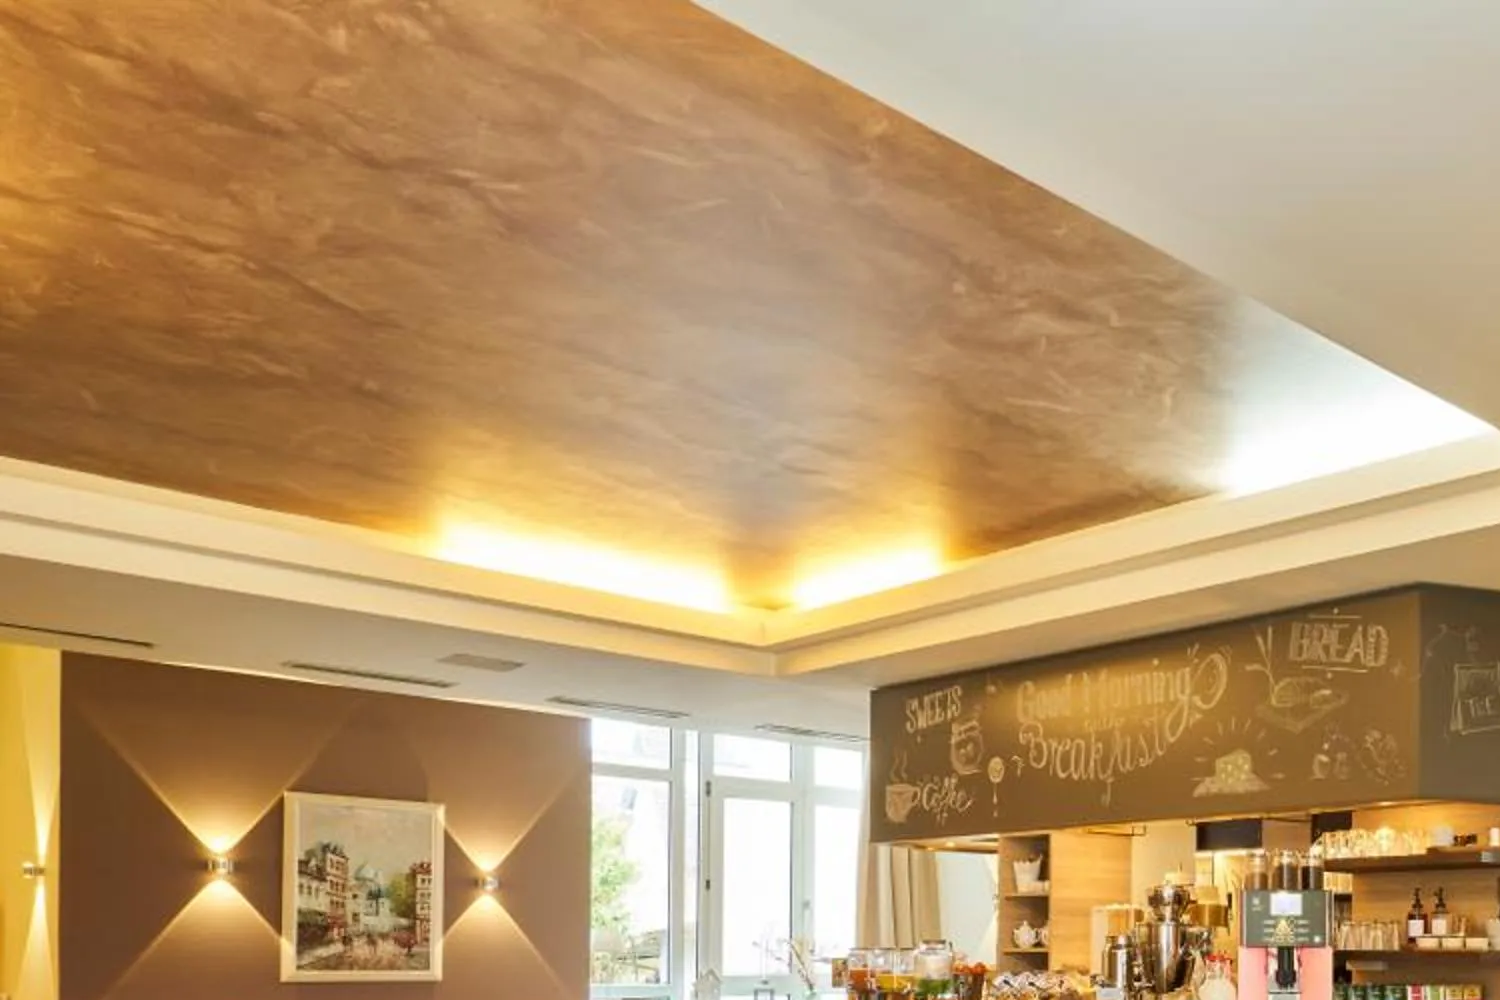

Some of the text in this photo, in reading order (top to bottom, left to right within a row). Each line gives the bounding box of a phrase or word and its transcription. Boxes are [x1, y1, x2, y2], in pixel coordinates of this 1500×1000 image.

[1289, 622, 1389, 668] BREAD
[905, 685, 963, 734] SWEETS
[1016, 656, 1192, 743] Good Morning
[1018, 708, 1168, 806] Breakfast
